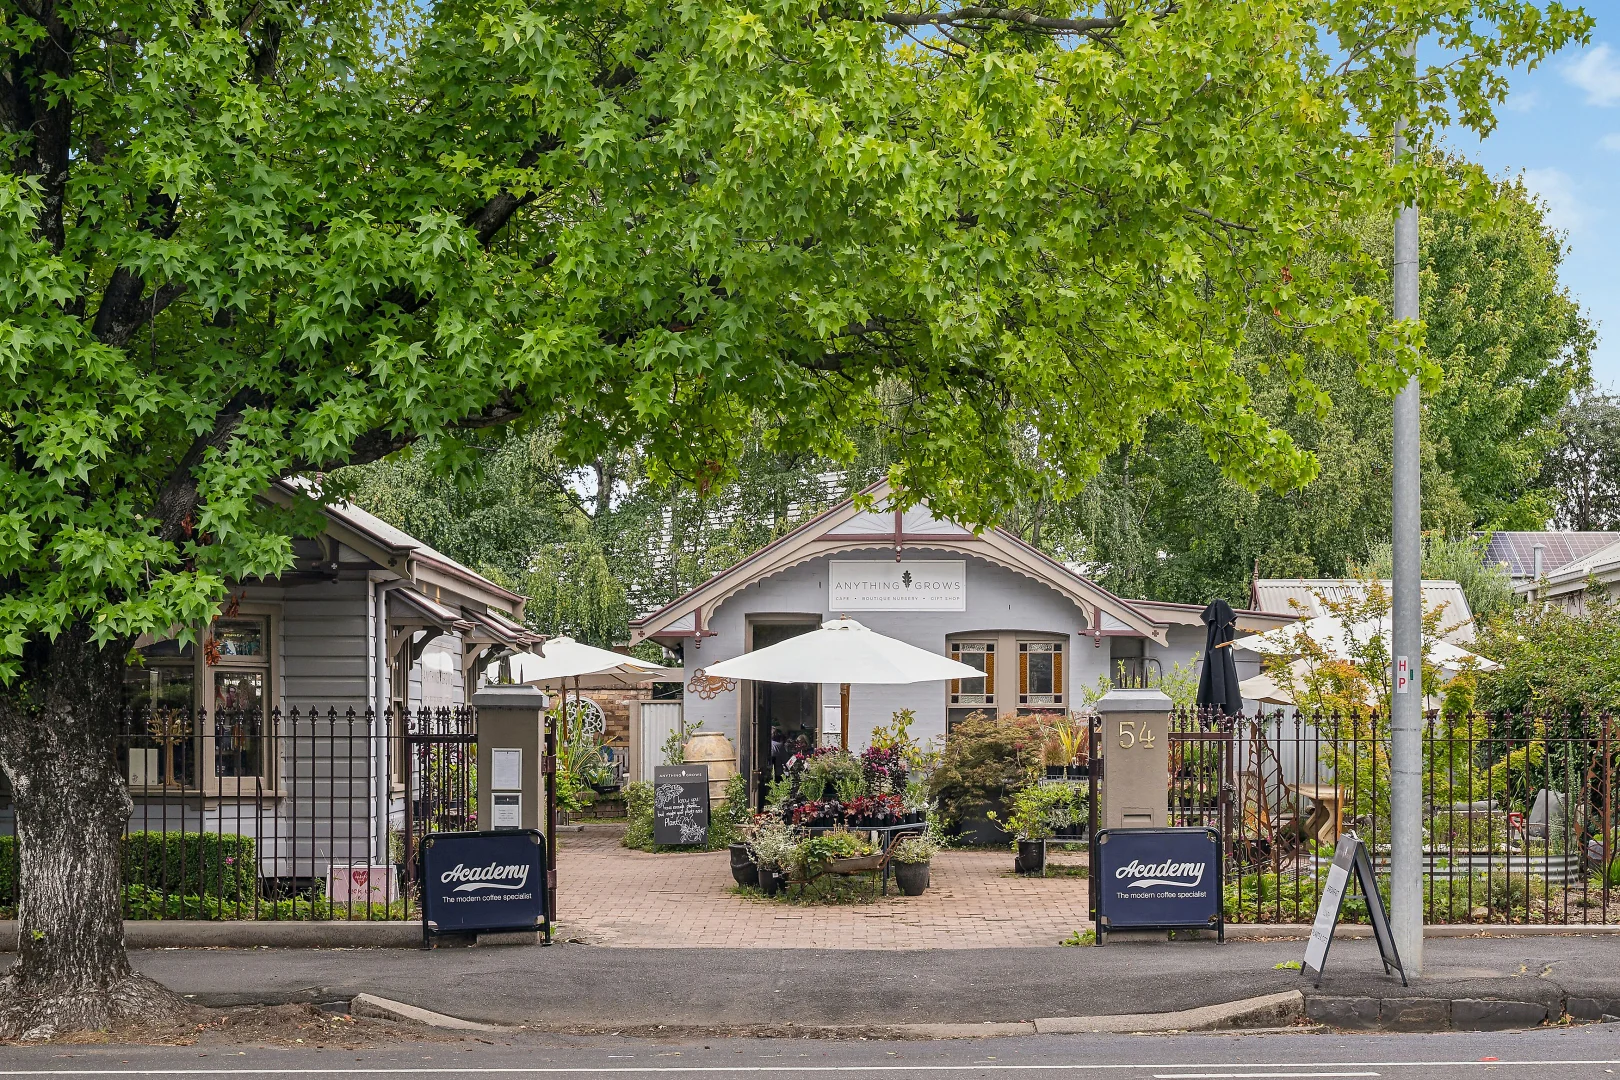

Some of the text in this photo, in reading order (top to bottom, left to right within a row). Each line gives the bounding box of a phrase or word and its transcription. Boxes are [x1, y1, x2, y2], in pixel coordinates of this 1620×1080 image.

[835, 581, 961, 590] ANYTHING GROWS
[1119, 721, 1156, 749] 54
[441, 862, 529, 892] Academy
[1116, 859, 1205, 888] Academy
[456, 895, 481, 903] modern
[482, 894, 502, 902] coffee
[502, 892, 532, 902] specialist
[1156, 891, 1176, 899] coffee
[1177, 890, 1207, 899] specialist
